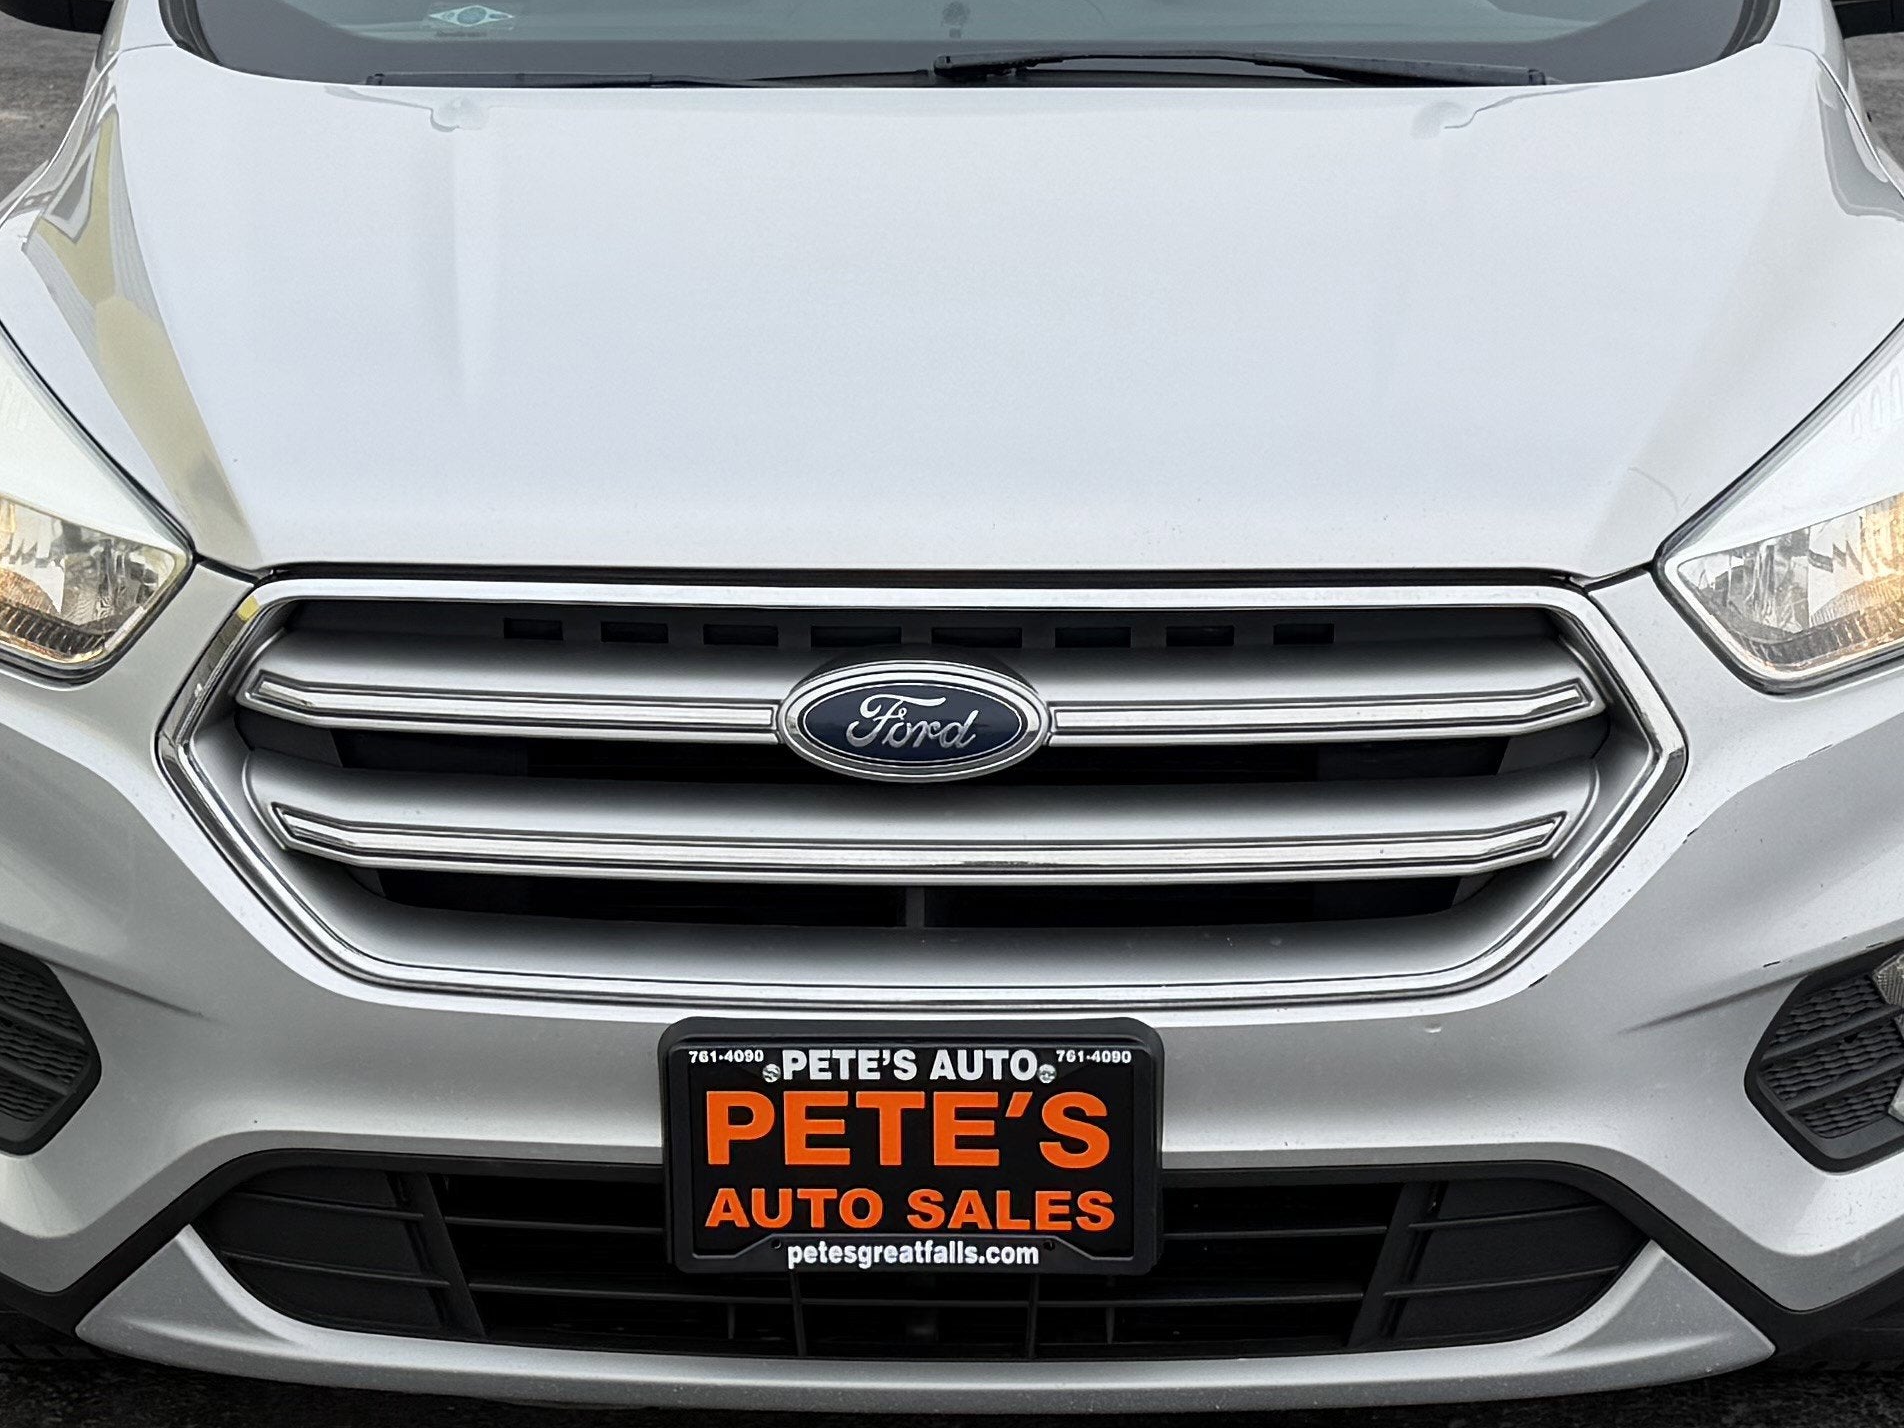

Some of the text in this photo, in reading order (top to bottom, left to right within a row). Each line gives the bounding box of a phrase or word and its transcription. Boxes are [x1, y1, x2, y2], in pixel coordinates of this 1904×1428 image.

[845, 693, 980, 749] Ford
[782, 1048, 1038, 1082] PETE'S AUTO
[705, 1090, 1110, 1169] PETE'S
[705, 1187, 1116, 1232] AUTO SALES
[787, 1239, 1040, 1270] petesgreatfalls.com
